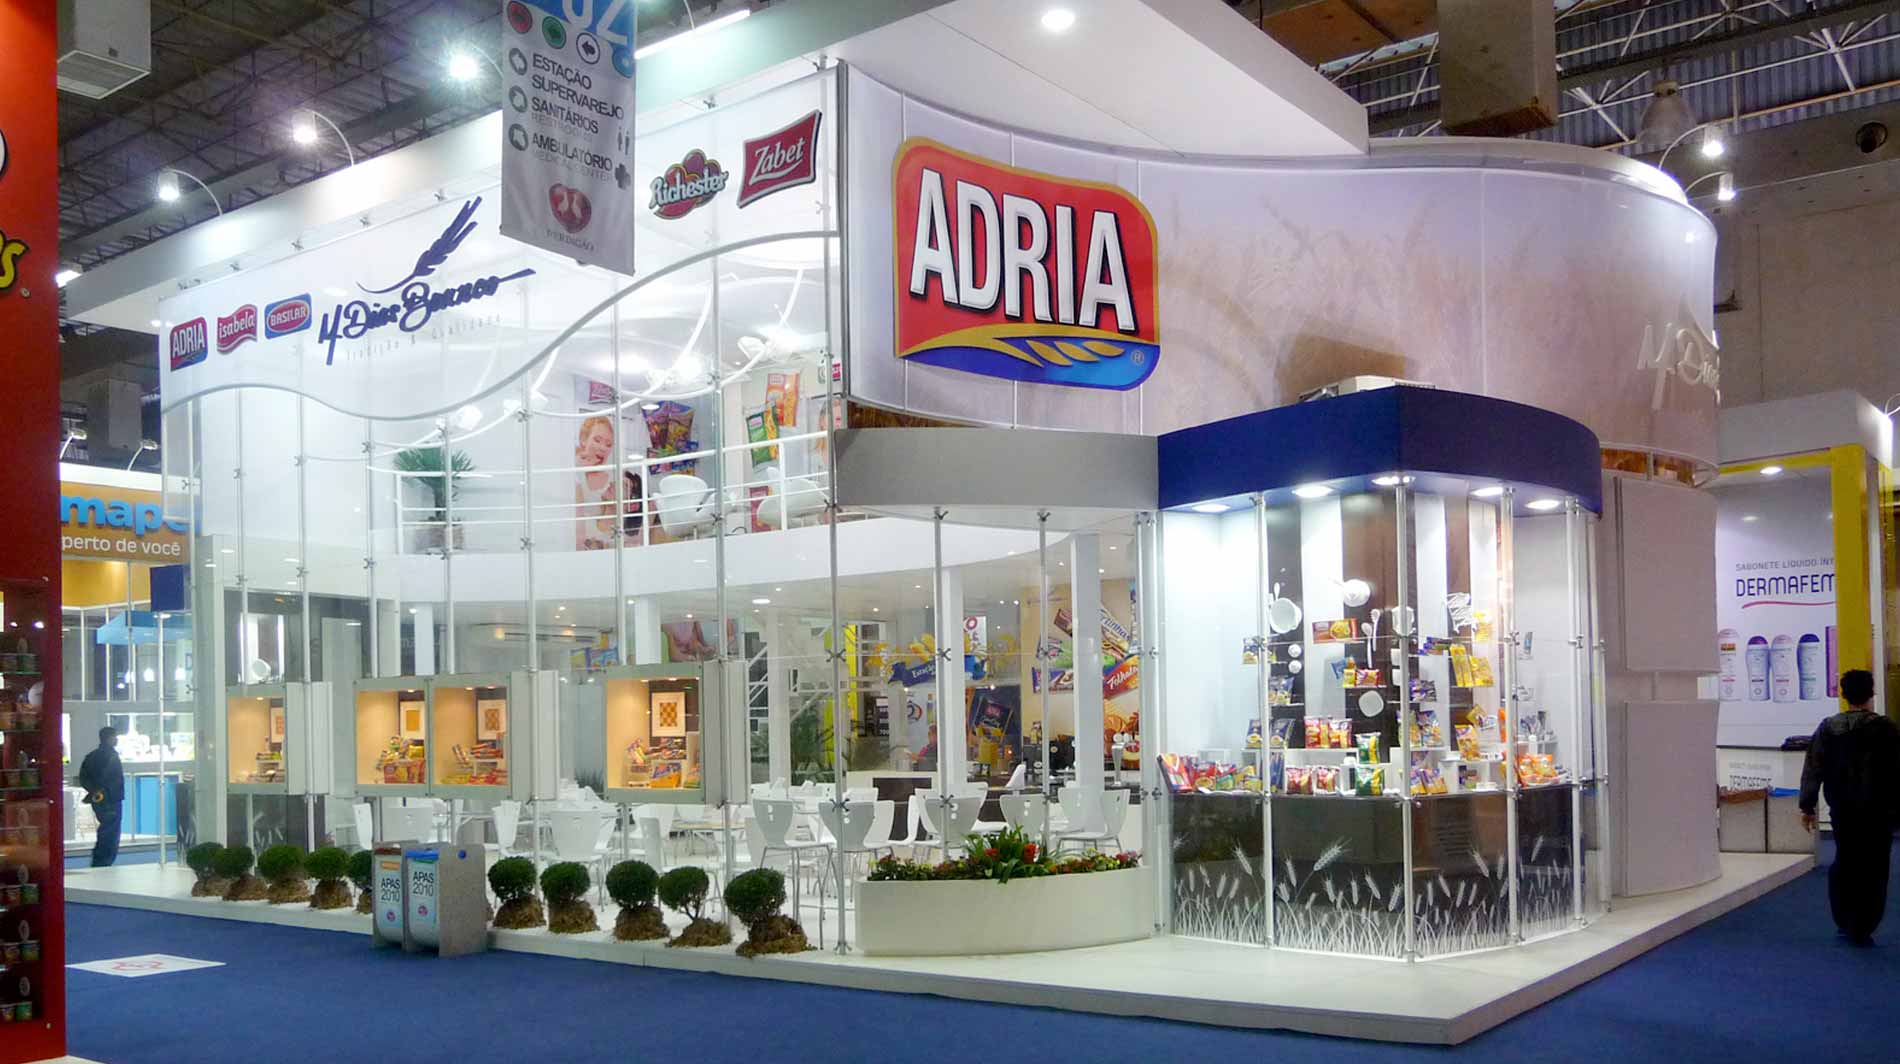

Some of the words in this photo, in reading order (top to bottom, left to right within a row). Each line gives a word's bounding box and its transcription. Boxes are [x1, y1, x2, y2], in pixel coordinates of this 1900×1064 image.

[532, 53, 592, 90] ESTAÇÃO
[531, 74, 624, 119] SUPERVAREJO
[531, 96, 599, 134] SANITÁRIOS
[532, 132, 613, 172] AMBULATÓRIO
[751, 137, 806, 186] Zabet
[649, 170, 730, 209] Richester
[910, 168, 1137, 333] ADRIA
[218, 309, 256, 338] isabela
[270, 306, 307, 327] BASILAR
[172, 324, 206, 359] ADRIA
[61, 535, 111, 553] perto
[116, 538, 137, 553] de
[142, 541, 181, 556] você
[381, 877, 401, 890] APAS
[412, 871, 434, 884] APAS
[412, 882, 434, 897] 2010
[381, 889, 400, 902] 2010
